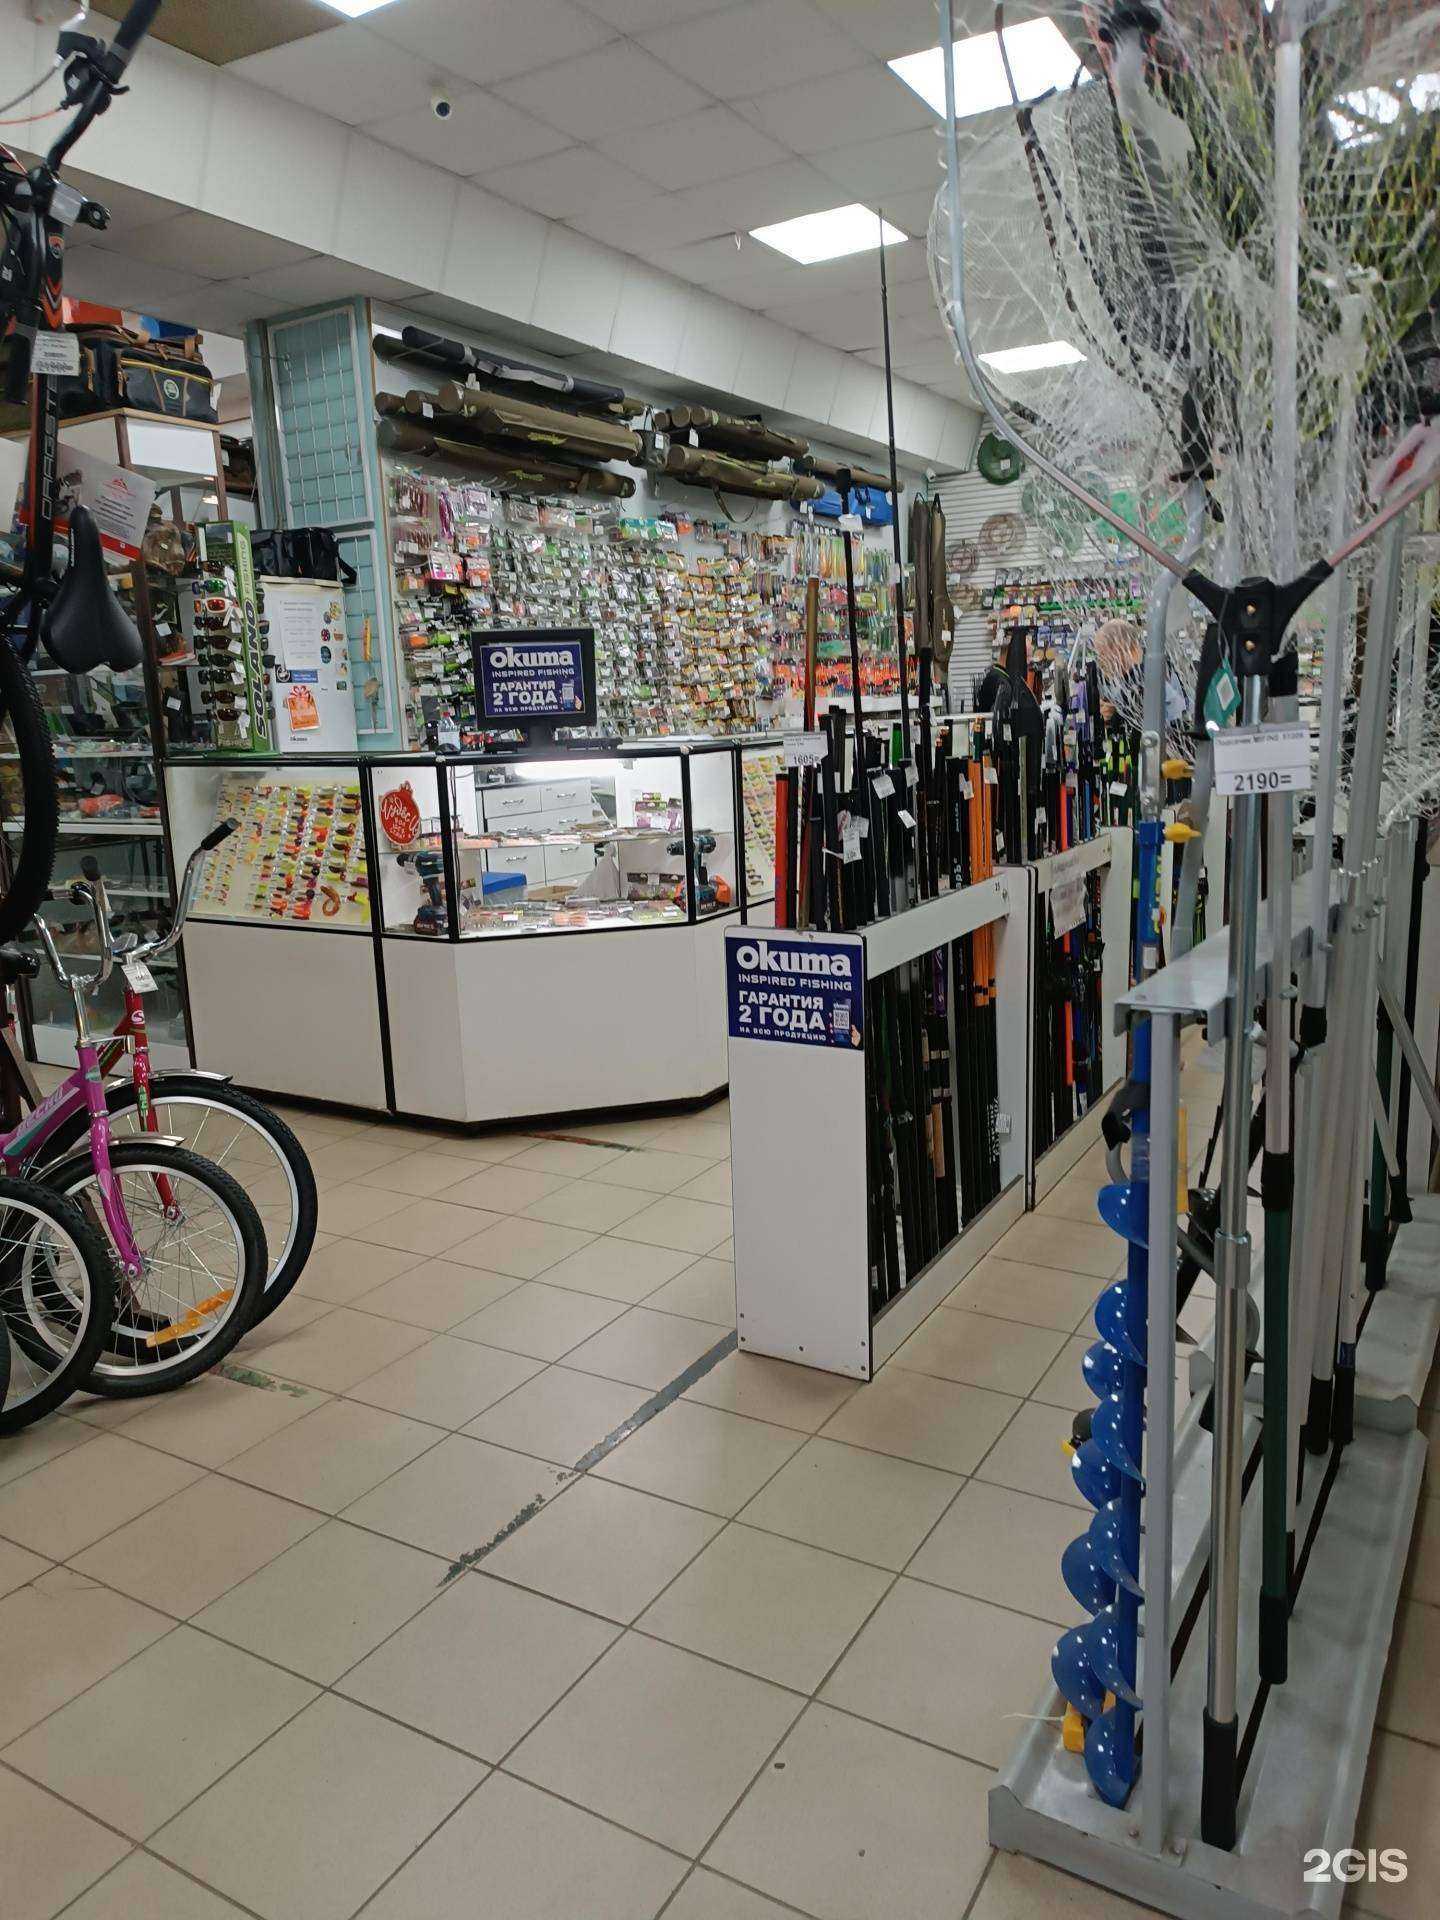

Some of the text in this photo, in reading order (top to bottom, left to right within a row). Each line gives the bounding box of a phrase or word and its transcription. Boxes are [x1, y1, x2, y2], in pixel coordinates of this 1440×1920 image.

[489, 647, 574, 668] okuma
[245, 600, 267, 739] SOLANO
[492, 667, 575, 678] INSPIRED FISHING
[492, 680, 556, 692] ГАРАНТИЯ
[493, 690, 558, 706] 2 ГОДА
[1234, 771, 1292, 792] 2190=
[736, 941, 853, 977] okuma
[738, 973, 852, 991] INSPIRED FISHING
[738, 990, 824, 1010] ГАРАНТИЯ
[738, 1004, 827, 1032] 2 ГОДА
[739, 1026, 827, 1041] НА ВСЮ ПРОДУКЦИЮ
